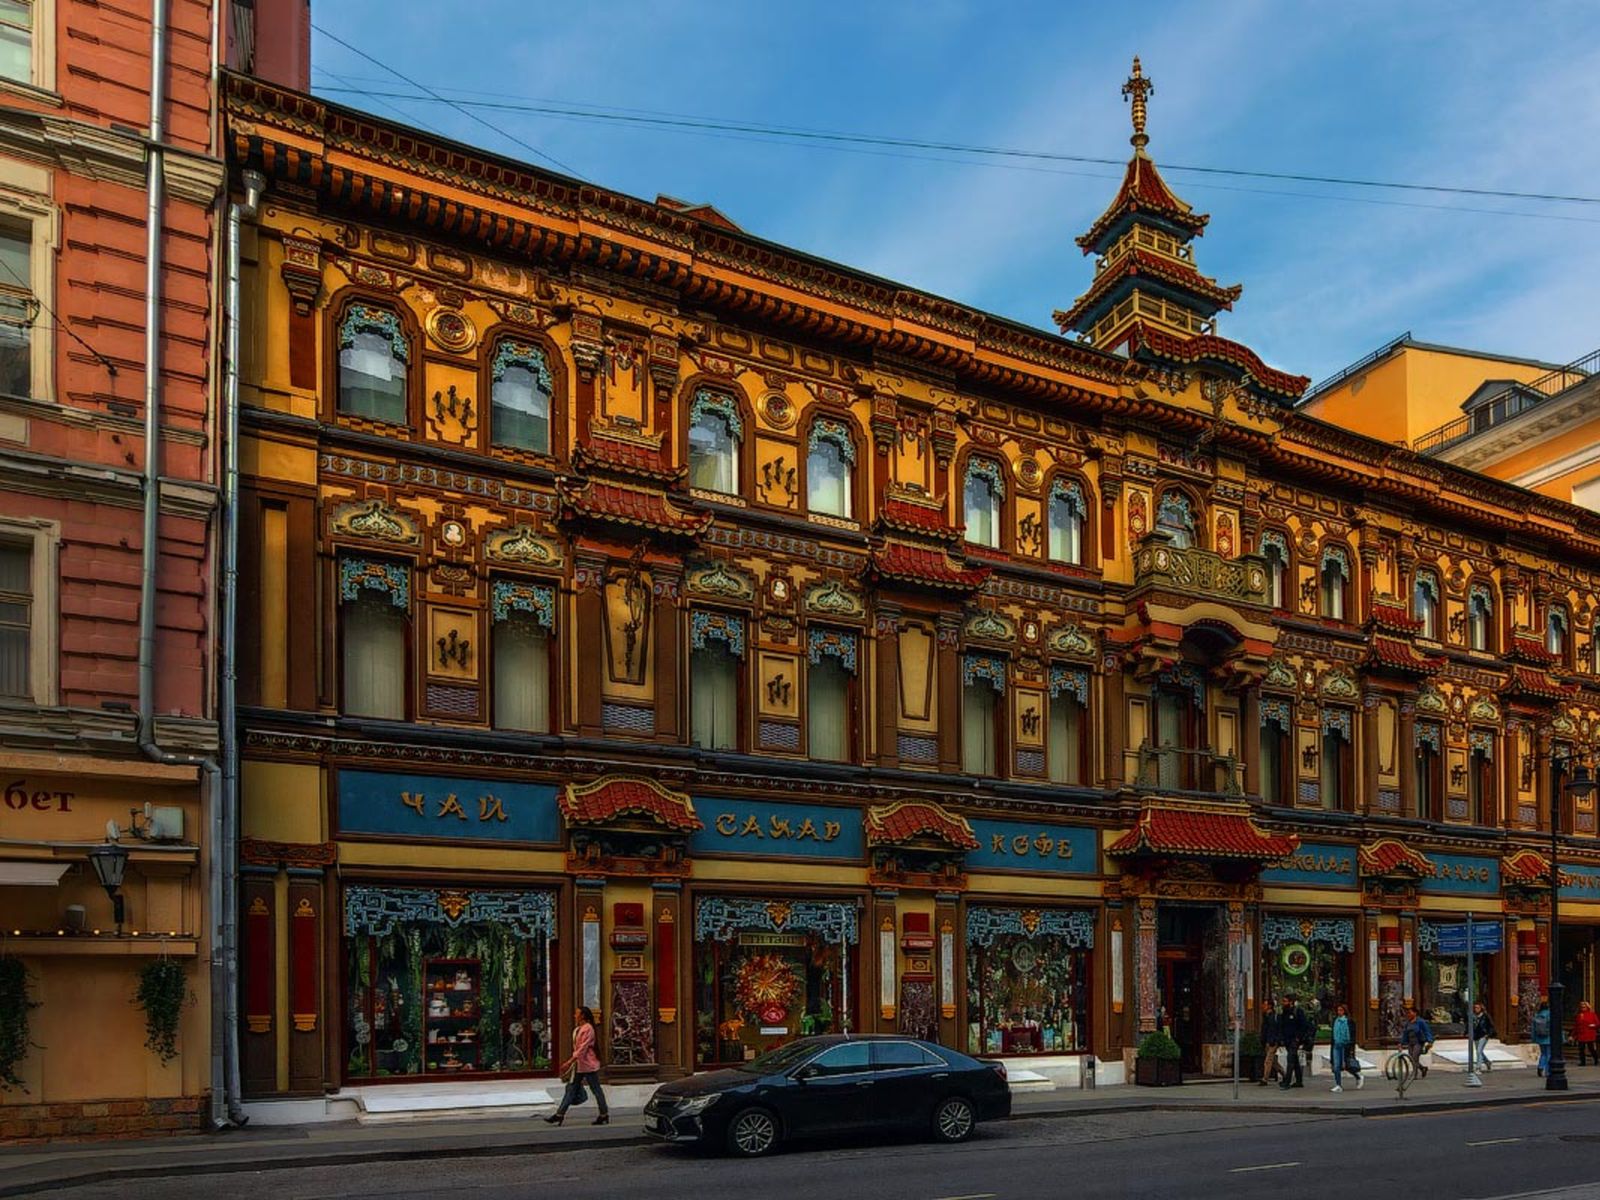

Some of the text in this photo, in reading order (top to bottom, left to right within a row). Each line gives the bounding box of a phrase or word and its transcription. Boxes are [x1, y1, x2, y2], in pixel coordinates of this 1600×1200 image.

[4, 779, 75, 812] бет
[401, 791, 508, 821] ЧАЙ
[716, 813, 841, 841] САХАР
[991, 832, 1073, 858] КОФЕ
